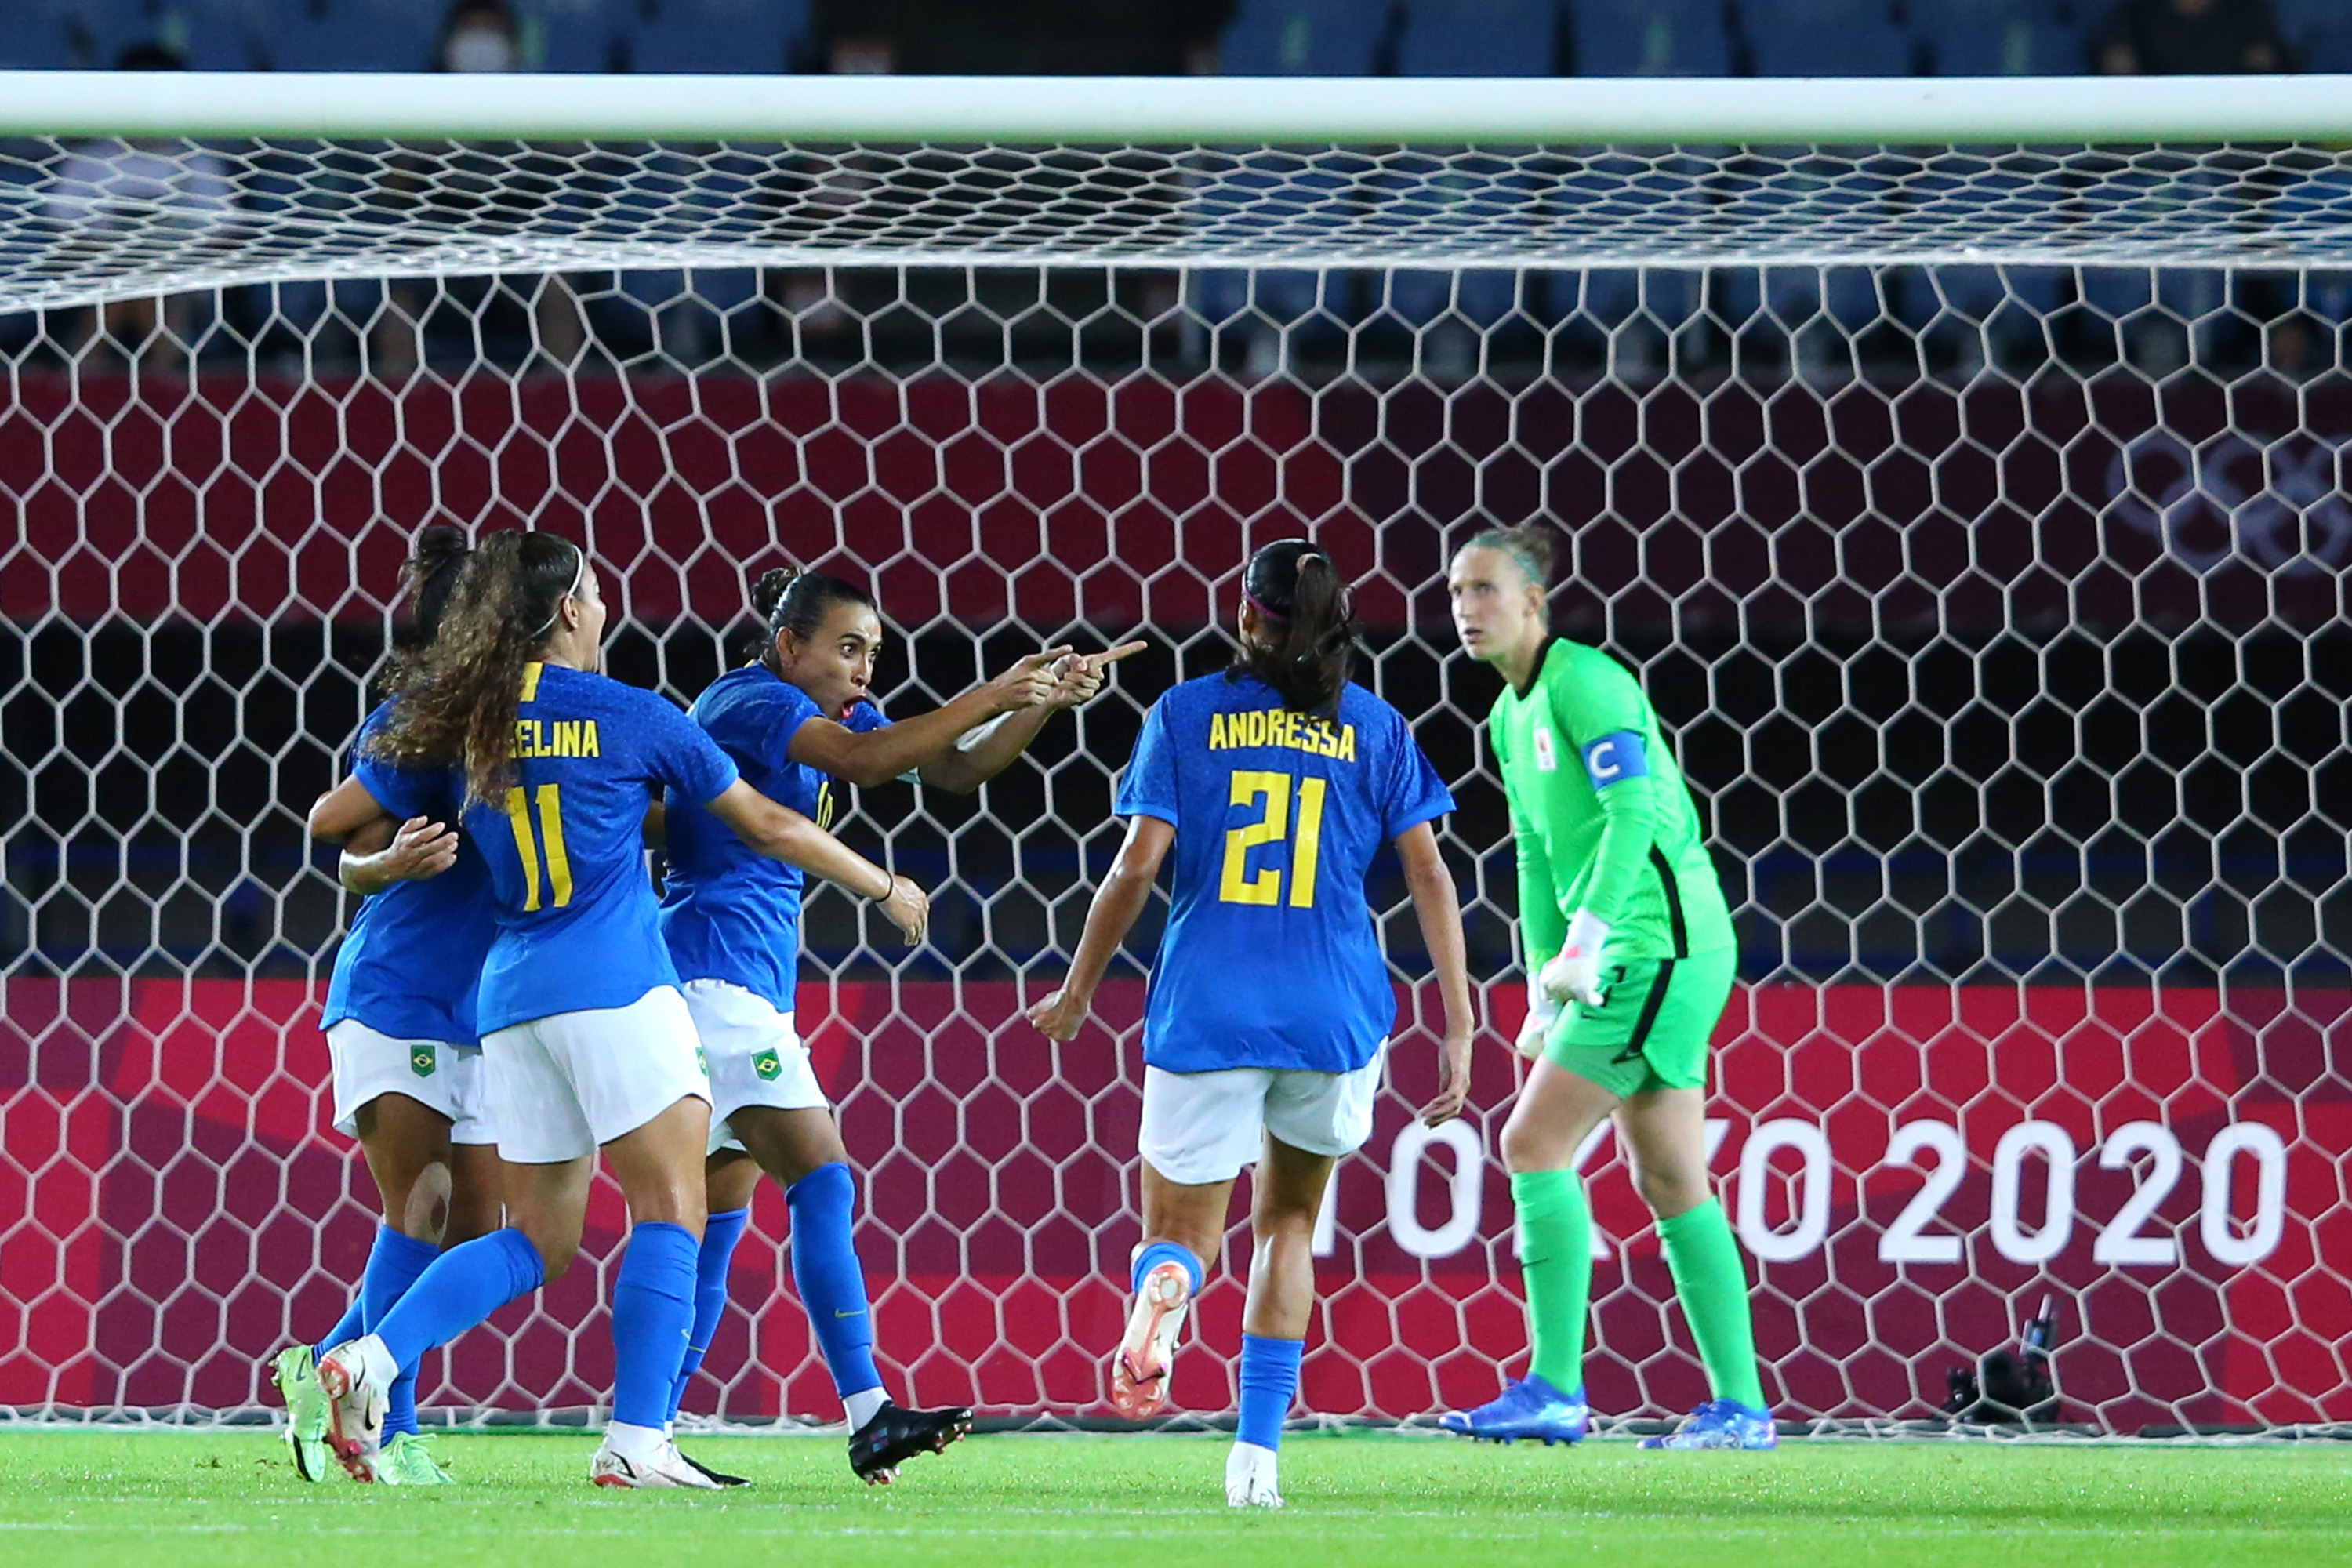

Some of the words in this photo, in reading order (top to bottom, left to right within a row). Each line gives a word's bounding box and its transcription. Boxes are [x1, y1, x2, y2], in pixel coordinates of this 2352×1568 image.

[508, 719, 600, 758] ELINA
[1209, 708, 1356, 763] ANDRESSA
[1589, 741, 1620, 778] C
[505, 783, 573, 911] 11
[1219, 770, 1326, 909] 21
[1878, 1118, 2287, 1265] 2020
